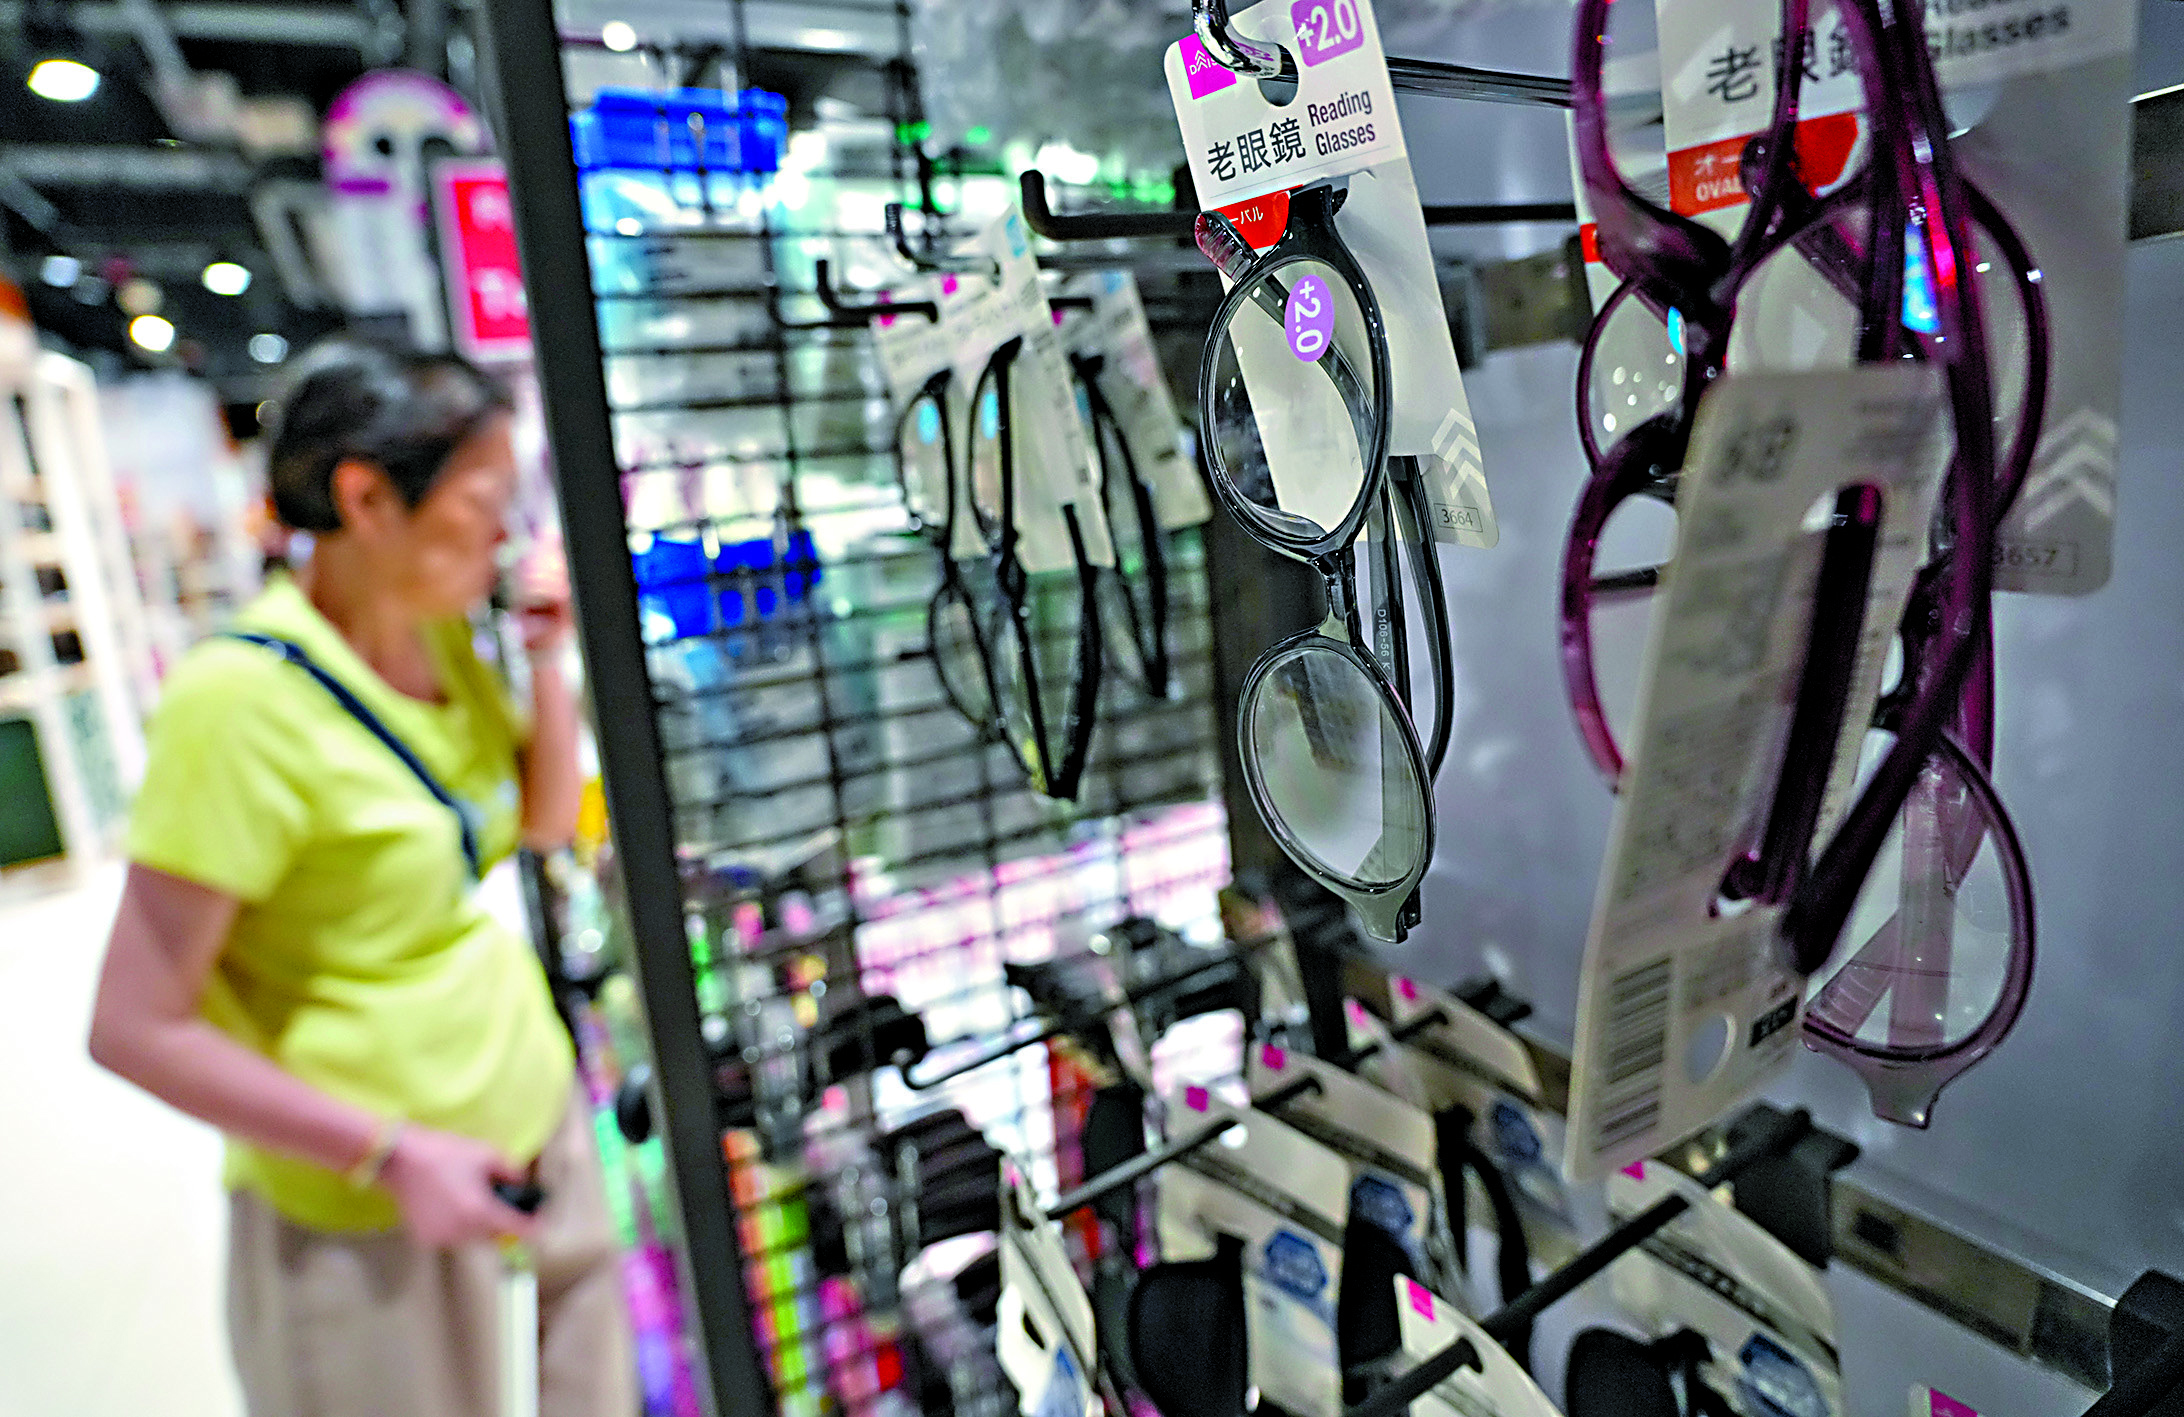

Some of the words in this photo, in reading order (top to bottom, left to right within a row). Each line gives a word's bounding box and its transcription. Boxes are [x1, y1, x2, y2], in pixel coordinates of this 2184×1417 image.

[1297, 0, 1357, 51] +2.0
[1307, 91, 1373, 127] Reading
[1207, 117, 1306, 182] 老眼鏡
[1315, 123, 1376, 156] Glasses
[1229, 206, 1264, 225] ーバル
[1294, 280, 1324, 354] +2.0
[1441, 508, 1473, 527] 3664
[1377, 608, 1390, 657] D106-56
[1381, 662, 1391, 670] K
